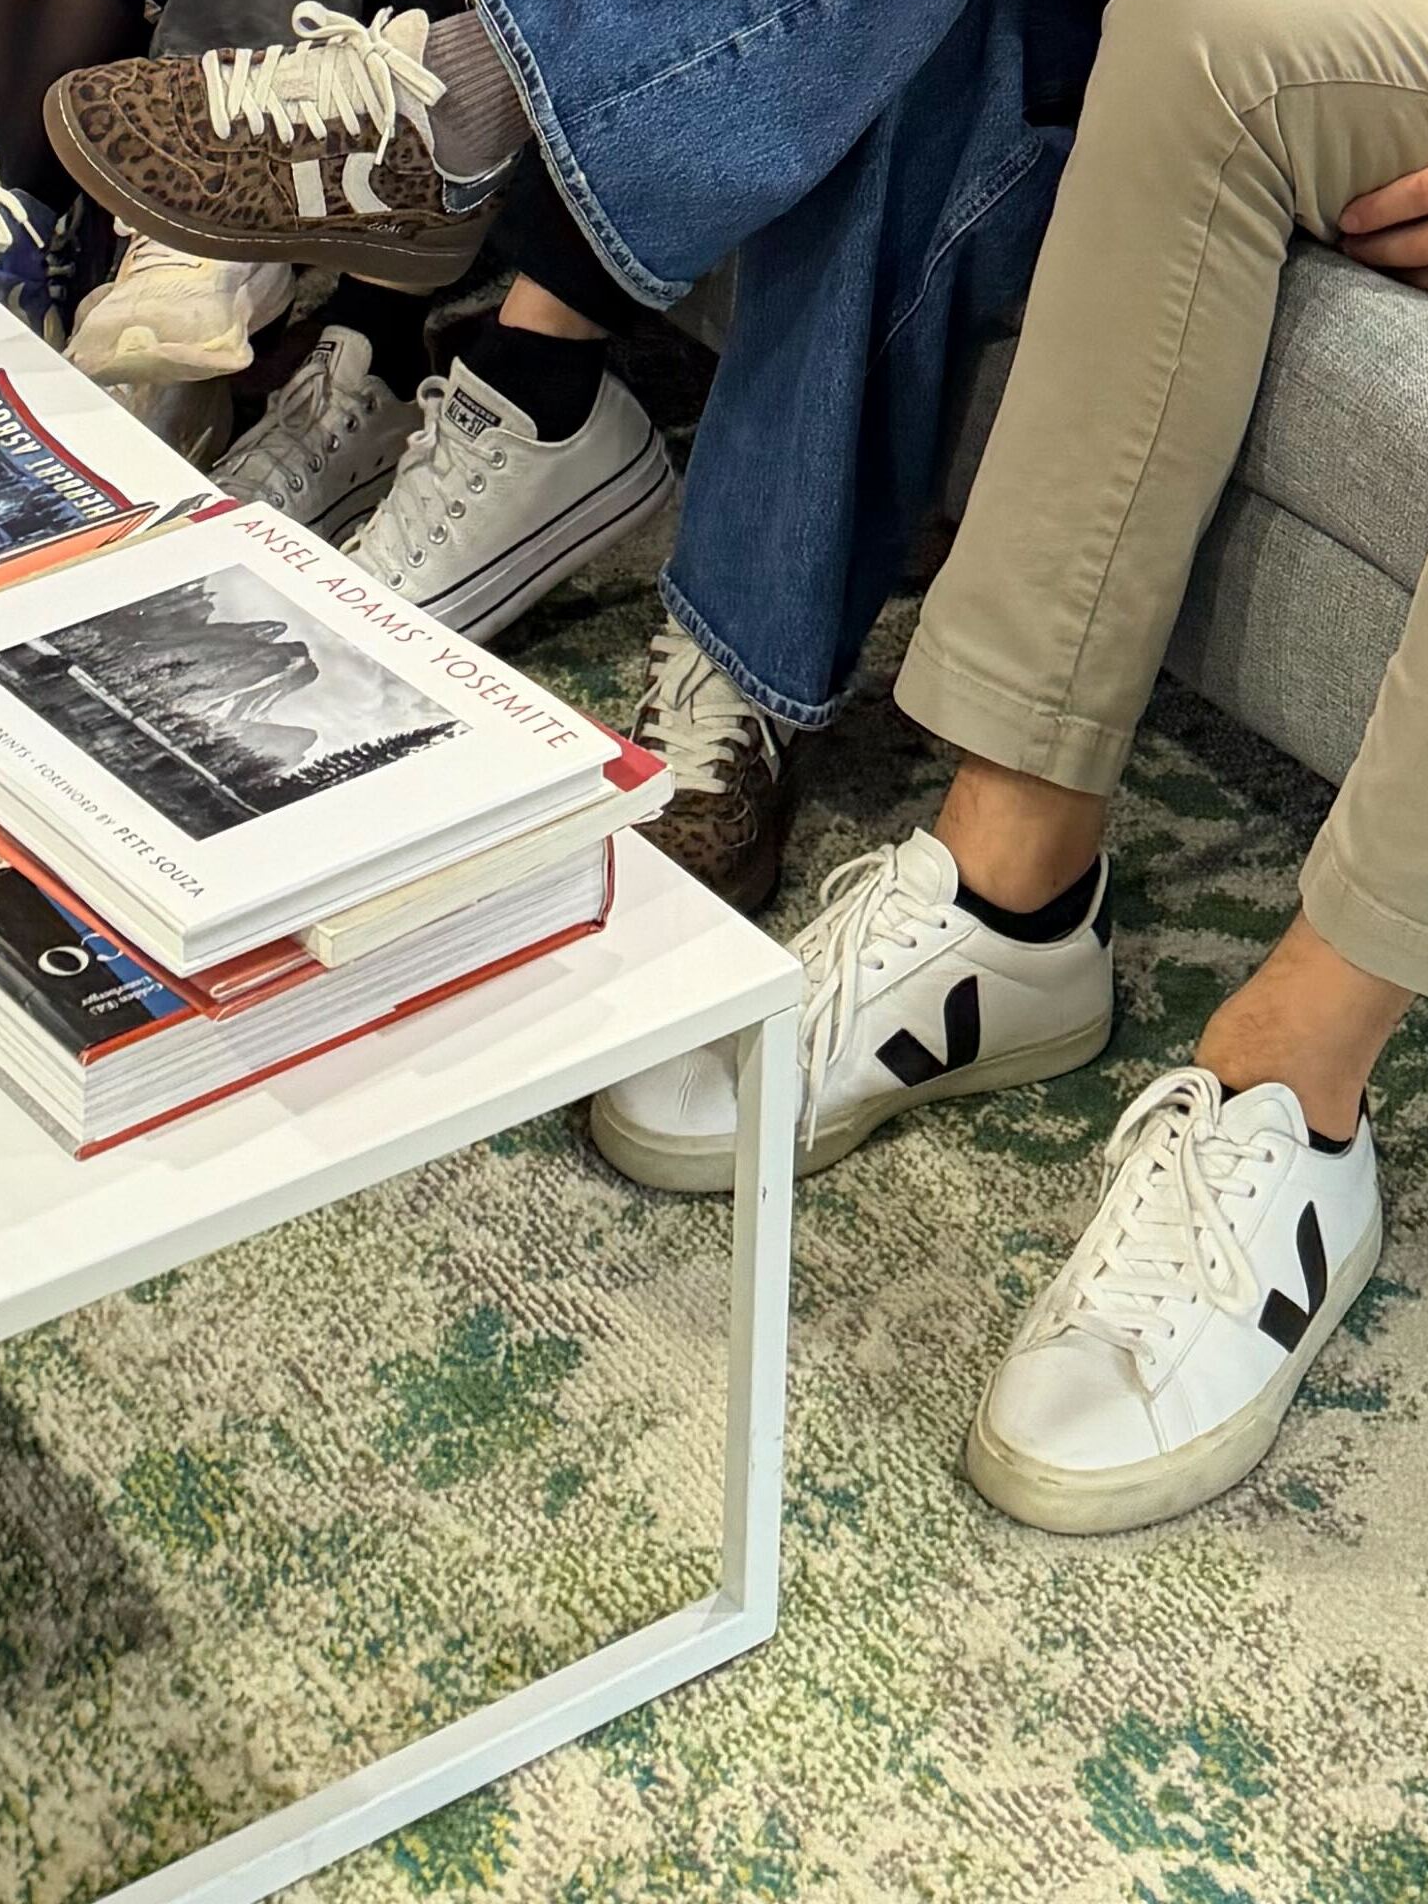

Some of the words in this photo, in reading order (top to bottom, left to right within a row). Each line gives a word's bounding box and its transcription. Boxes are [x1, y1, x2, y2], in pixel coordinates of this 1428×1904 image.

[24, 457, 117, 519] HERBERT
[234, 519, 321, 573] ANSEL
[429, 647, 579, 750] YOSEMITE
[33, 762, 100, 814] FOREWORD
[94, 806, 116, 827] BY
[112, 826, 155, 858] PETE
[148, 854, 207, 899] SOUZA
